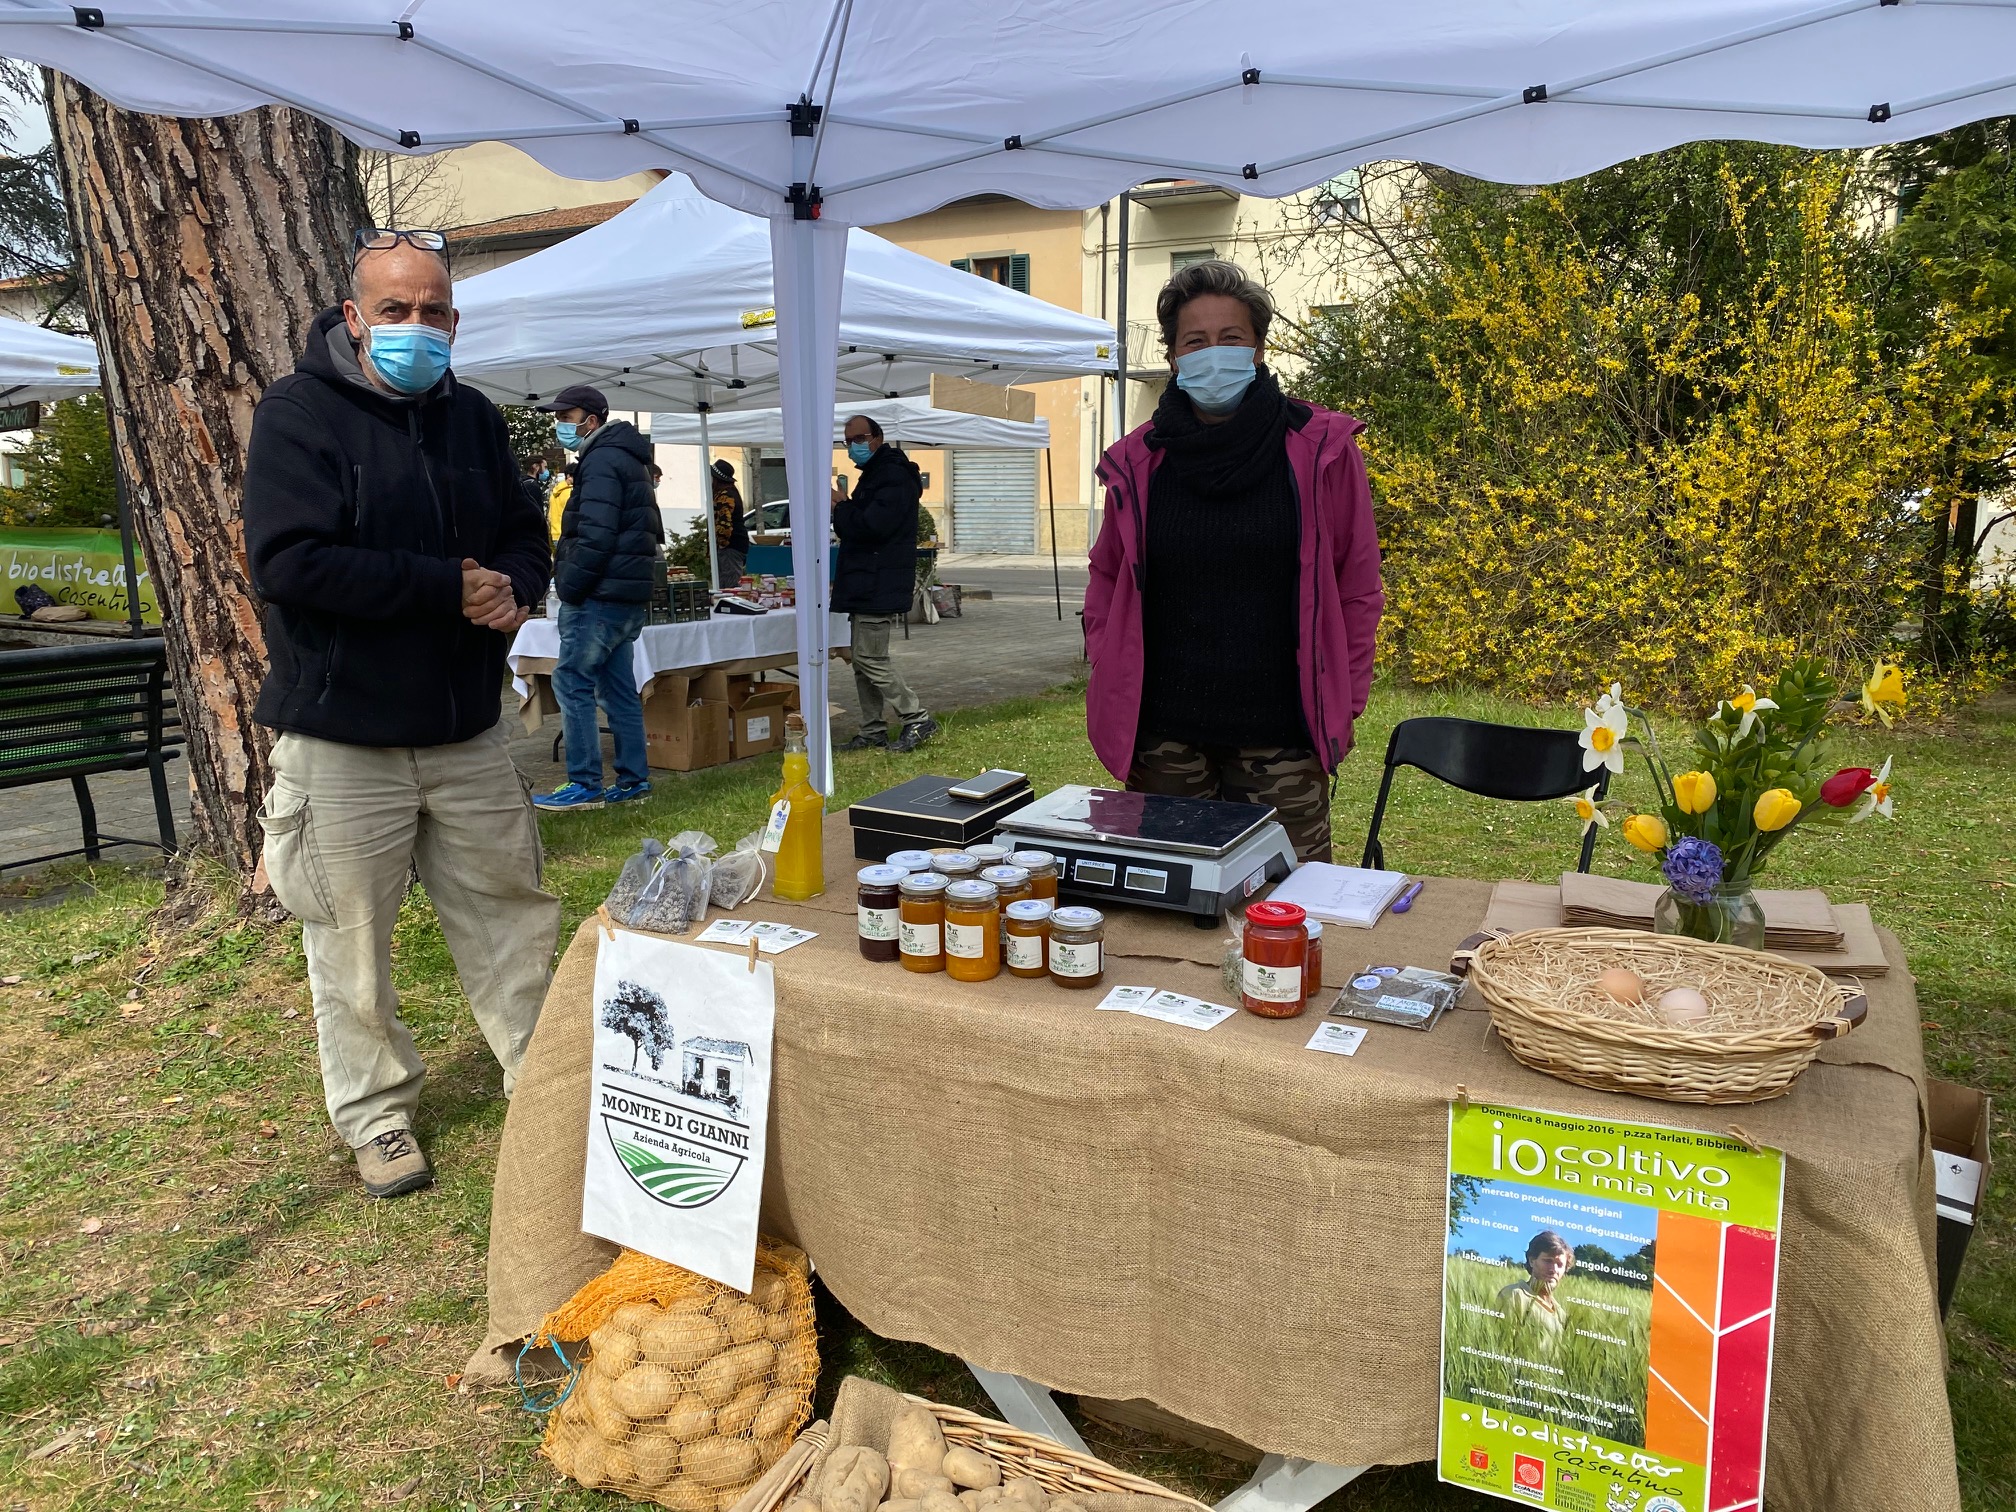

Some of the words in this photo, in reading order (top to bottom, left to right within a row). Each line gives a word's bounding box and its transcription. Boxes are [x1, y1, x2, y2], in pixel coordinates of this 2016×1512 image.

[602, 1093, 661, 1124] MONTE
[664, 1111, 684, 1131] DI
[687, 1118, 750, 1151] GIANNI
[1481, 1105, 1533, 1123] Domenica
[1534, 1116, 1542, 1124] 8
[1544, 1119, 1585, 1132] maggio
[1587, 1123, 1615, 1135] 2016
[1623, 1129, 1652, 1140] p.zza
[1654, 1131, 1693, 1146] Tarlati,
[1696, 1137, 1748, 1153] Bibbiena
[632, 1131, 670, 1151] Azienda
[671, 1143, 711, 1164] Agricola
[1492, 1119, 1547, 1176] io
[1554, 1144, 1731, 1187] coltivo
[1481, 1186, 1520, 1199] mercato
[1521, 1192, 1571, 1210] produttori
[1580, 1204, 1623, 1219] artigiani
[1554, 1164, 1582, 1184] la
[1592, 1174, 1655, 1197] mia
[1664, 1186, 1730, 1211] vita
[1460, 1214, 1479, 1226] orto
[1481, 1217, 1491, 1227] in
[1492, 1221, 1519, 1233] conca
[1531, 1213, 1565, 1228] molino
[1566, 1221, 1584, 1231] con
[1585, 1222, 1652, 1246] degustazione
[1462, 1251, 1508, 1268] laboratori
[1575, 1259, 1610, 1274] angolo
[1611, 1266, 1648, 1282] olistico
[1460, 1301, 1505, 1319] biblioteca
[1566, 1294, 1600, 1310] scatole
[1601, 1302, 1630, 1316] tattili
[1575, 1327, 1627, 1347] smielatura
[1460, 1344, 1512, 1364] educazione
[1513, 1357, 1564, 1376] alimentare
[1470, 1386, 1542, 1410] microorganismi
[1543, 1404, 1559, 1416] per
[1561, 1408, 1614, 1429] agricoltura
[1514, 1377, 1569, 1397] costruzione
[1570, 1391, 1591, 1403] case
[1593, 1395, 1602, 1405] in
[1604, 1400, 1635, 1416] paglia
[1481, 1407, 1684, 1477] biodistretto
